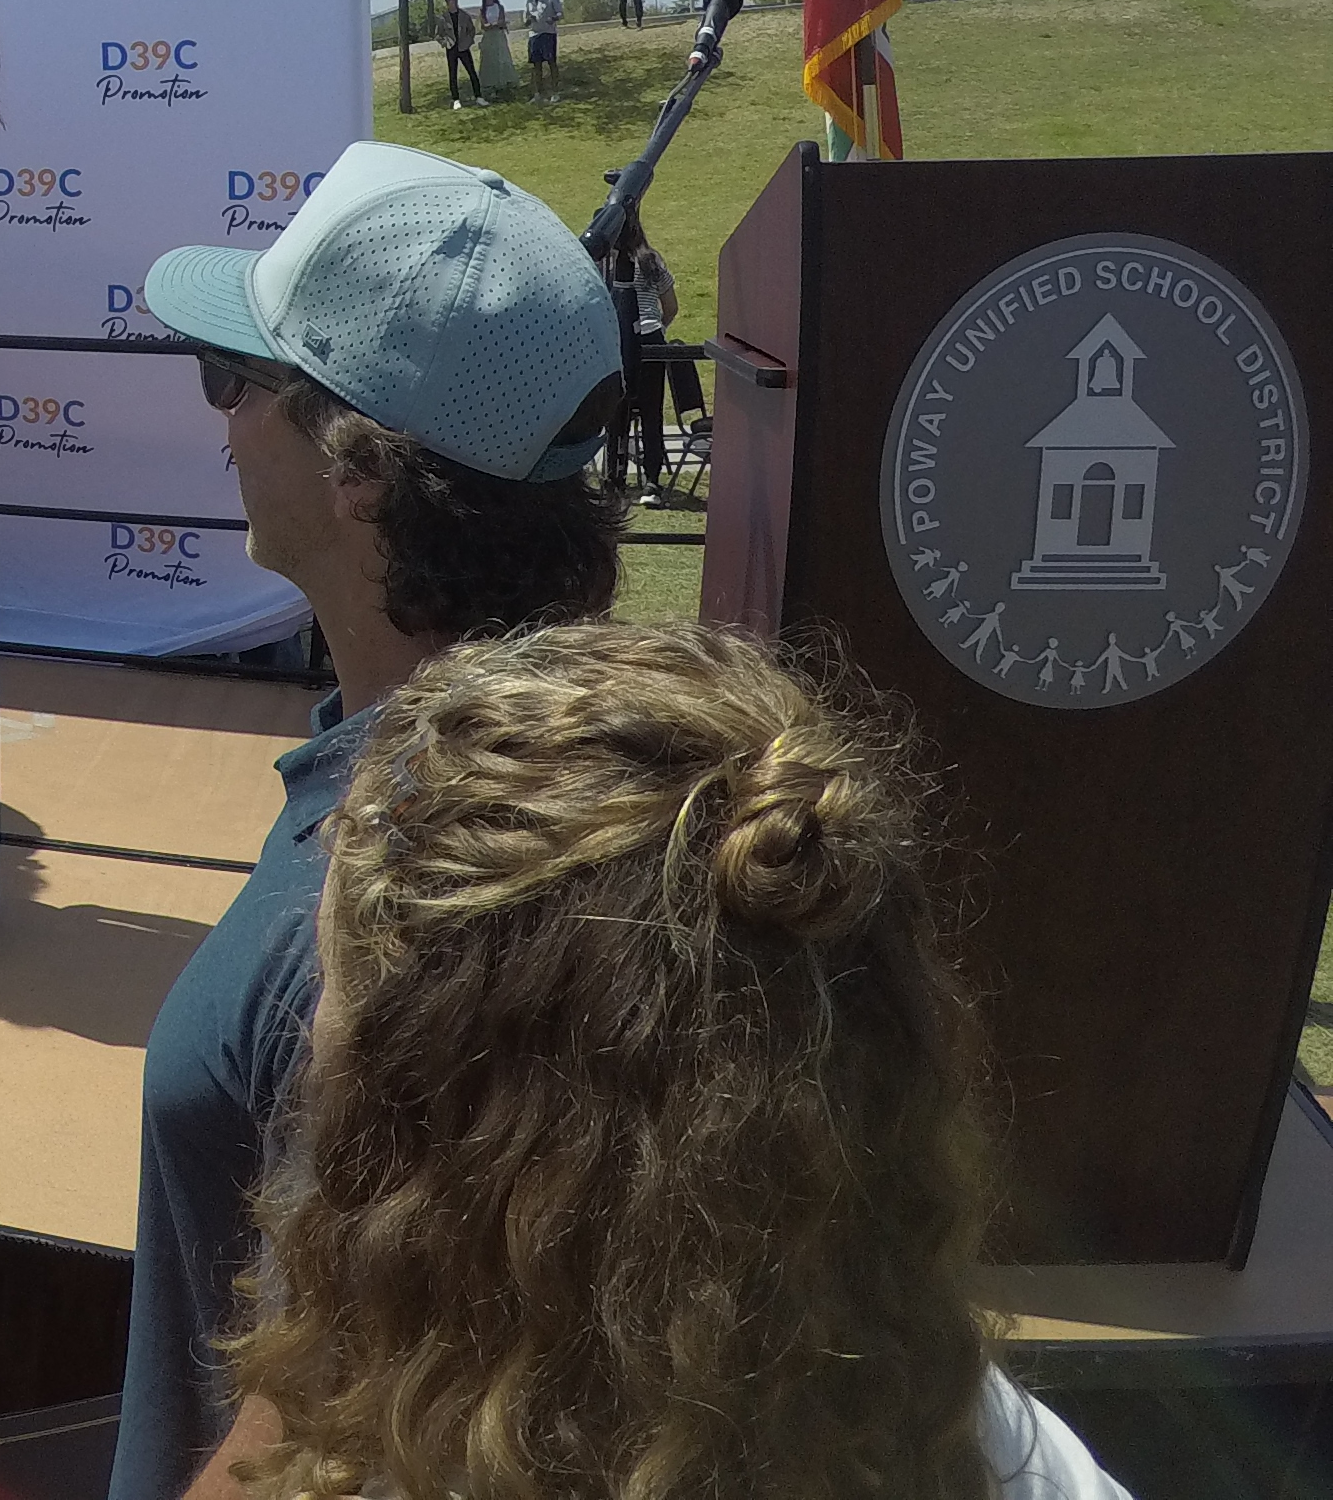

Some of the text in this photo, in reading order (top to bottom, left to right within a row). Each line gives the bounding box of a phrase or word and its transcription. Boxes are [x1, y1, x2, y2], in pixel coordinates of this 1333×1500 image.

[102, 40, 198, 71] D39C
[96, 74, 208, 107] Promotion
[908, 260, 1286, 535] POWAY UNIFIED SCHOOL DISTRICT
[110, 523, 201, 559] D39C
[104, 553, 207, 589] Promotion
